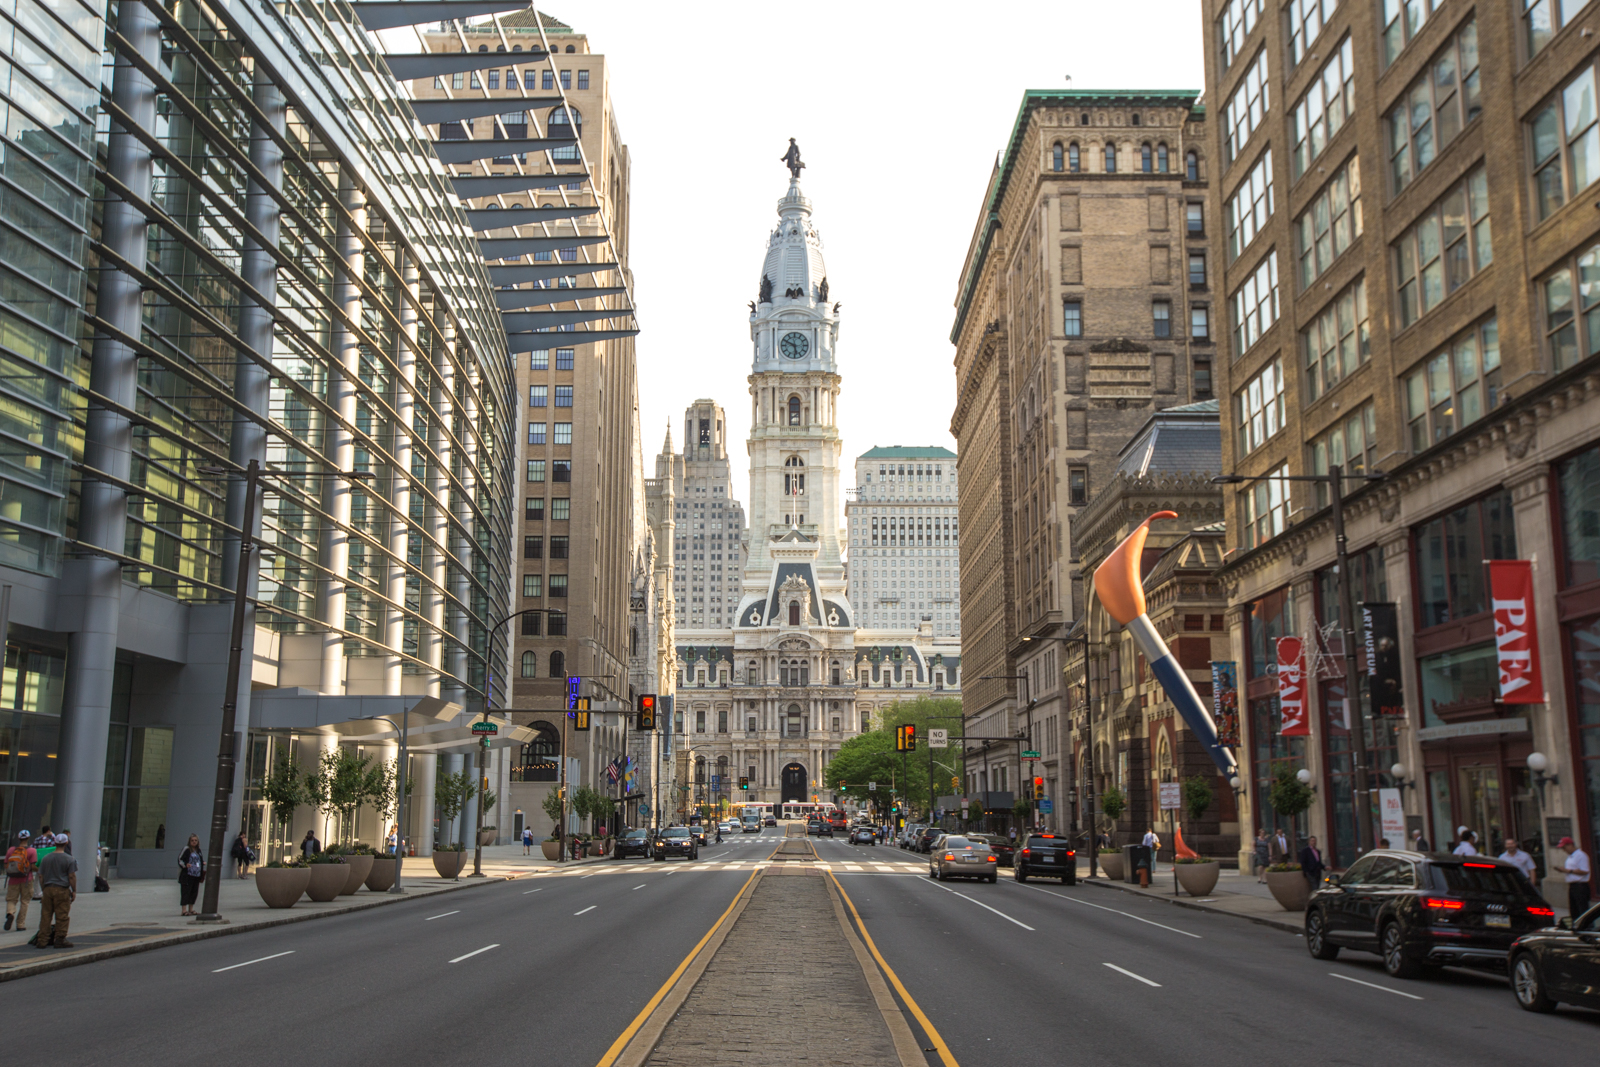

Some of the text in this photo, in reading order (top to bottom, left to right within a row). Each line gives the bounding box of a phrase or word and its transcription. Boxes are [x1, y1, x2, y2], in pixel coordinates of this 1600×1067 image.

[1362, 607, 1377, 677] ART MUSEUM
[1492, 596, 1533, 697] PAFA
[1213, 682, 1221, 716] MUSEUM
[1277, 664, 1303, 731] PAFA
